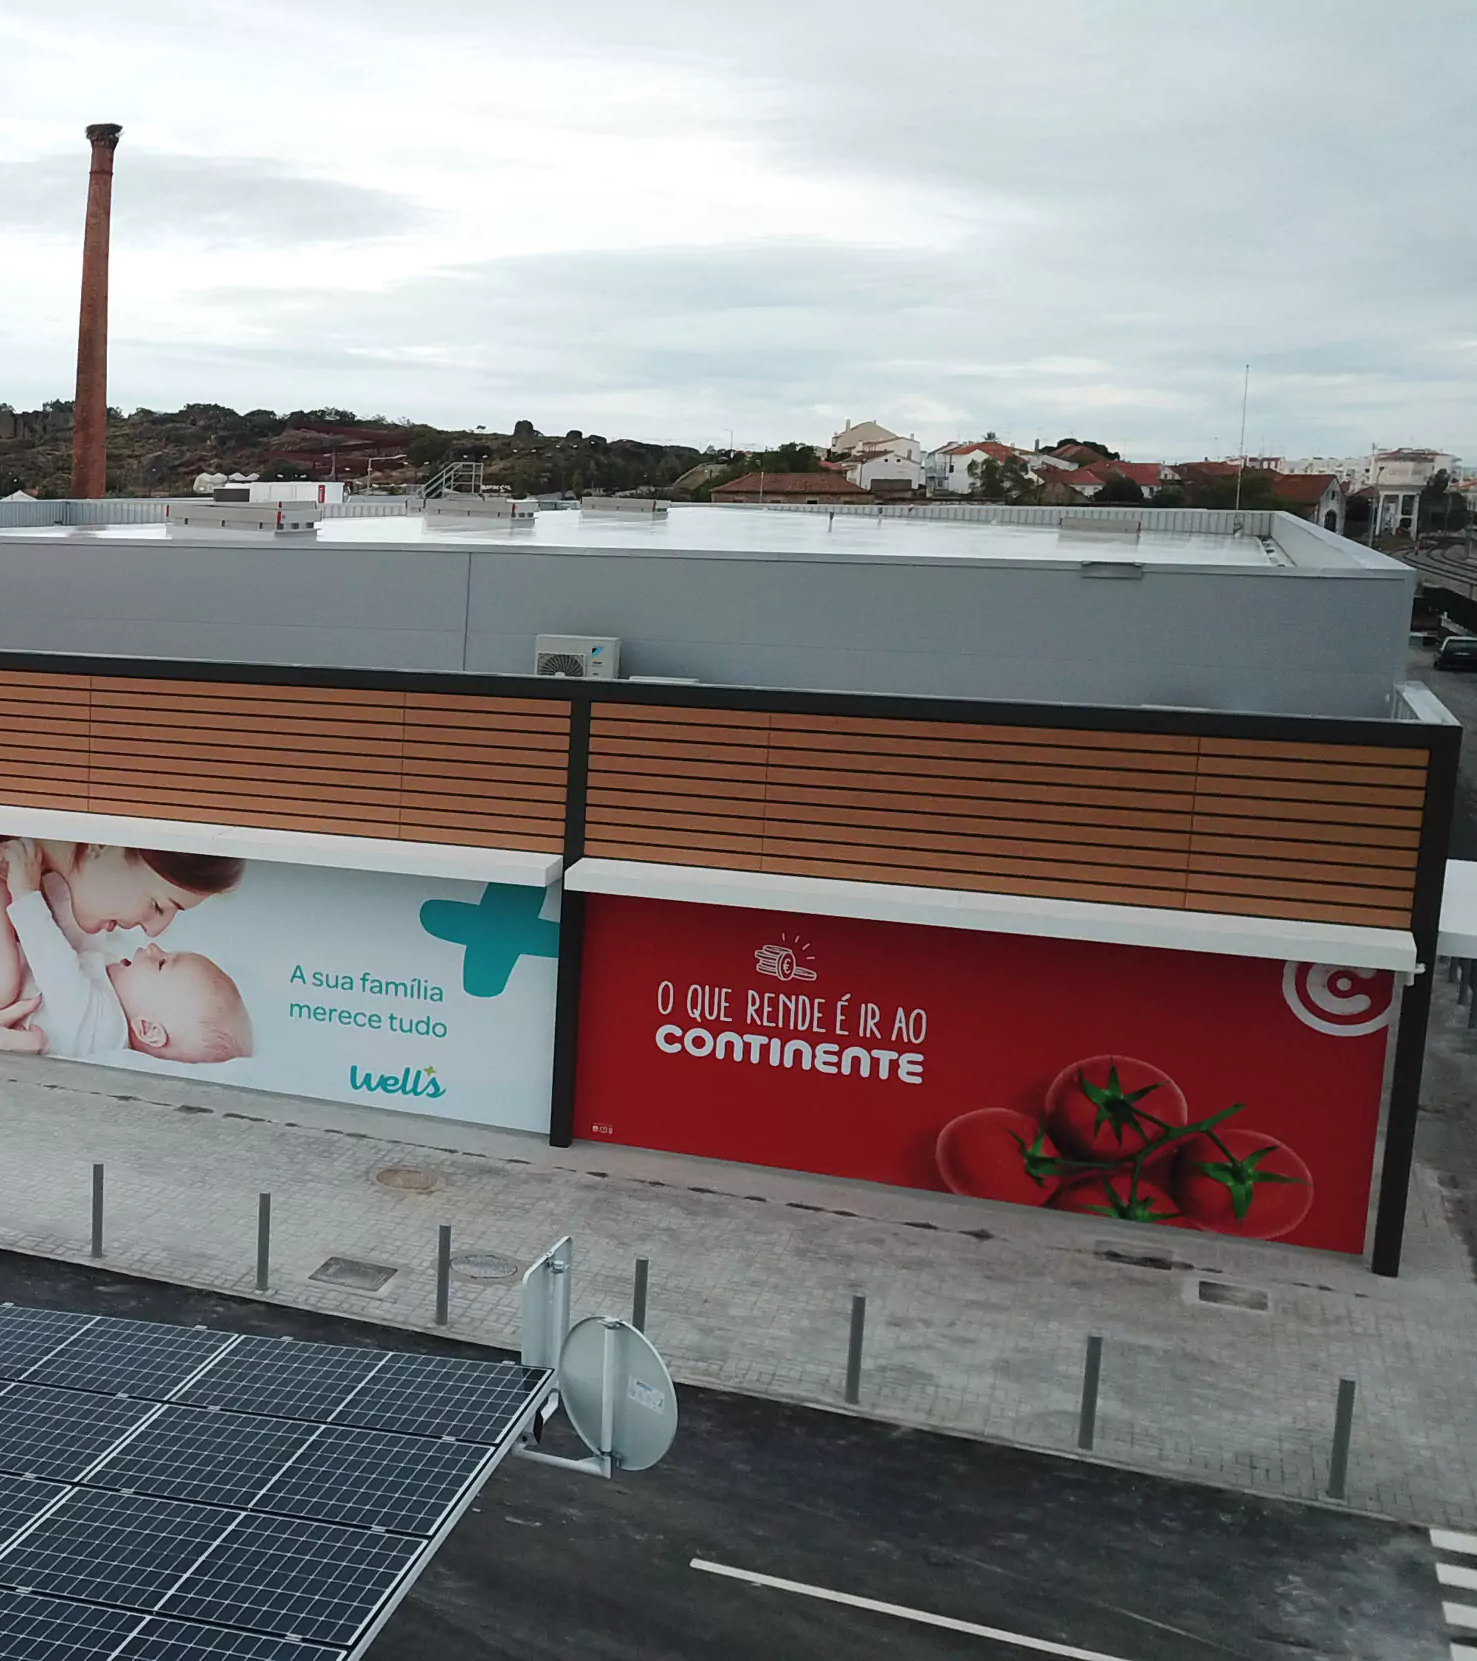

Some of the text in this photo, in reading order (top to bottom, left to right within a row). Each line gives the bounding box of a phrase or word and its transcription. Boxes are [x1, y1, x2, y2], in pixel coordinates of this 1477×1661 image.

[289, 964, 444, 1002] A sua família
[289, 1002, 448, 1038] merece tudo
[657, 980, 928, 1044] O QUE RENDE É IR AO
[655, 1023, 925, 1085] CONTINENTE
